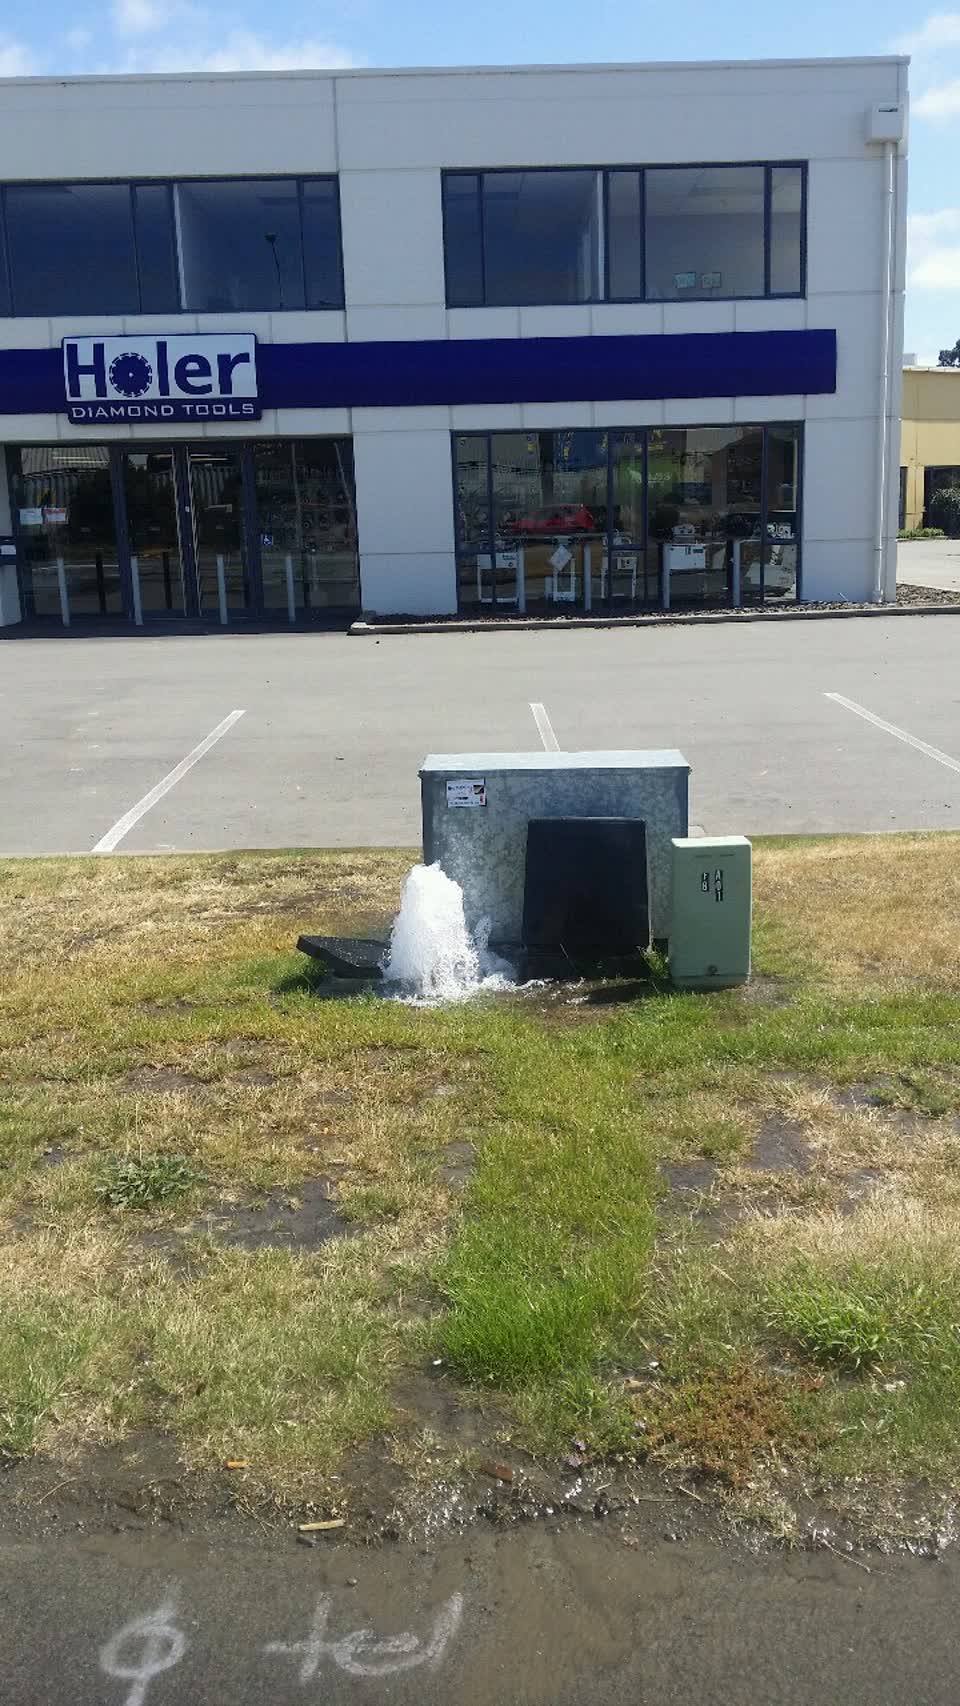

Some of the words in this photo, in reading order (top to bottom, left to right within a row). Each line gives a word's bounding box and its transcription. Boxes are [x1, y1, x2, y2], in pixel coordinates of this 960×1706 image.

[66, 341, 250, 398] Holer
[71, 405, 174, 418] DIAMOND
[182, 403, 255, 416] TOOLS
